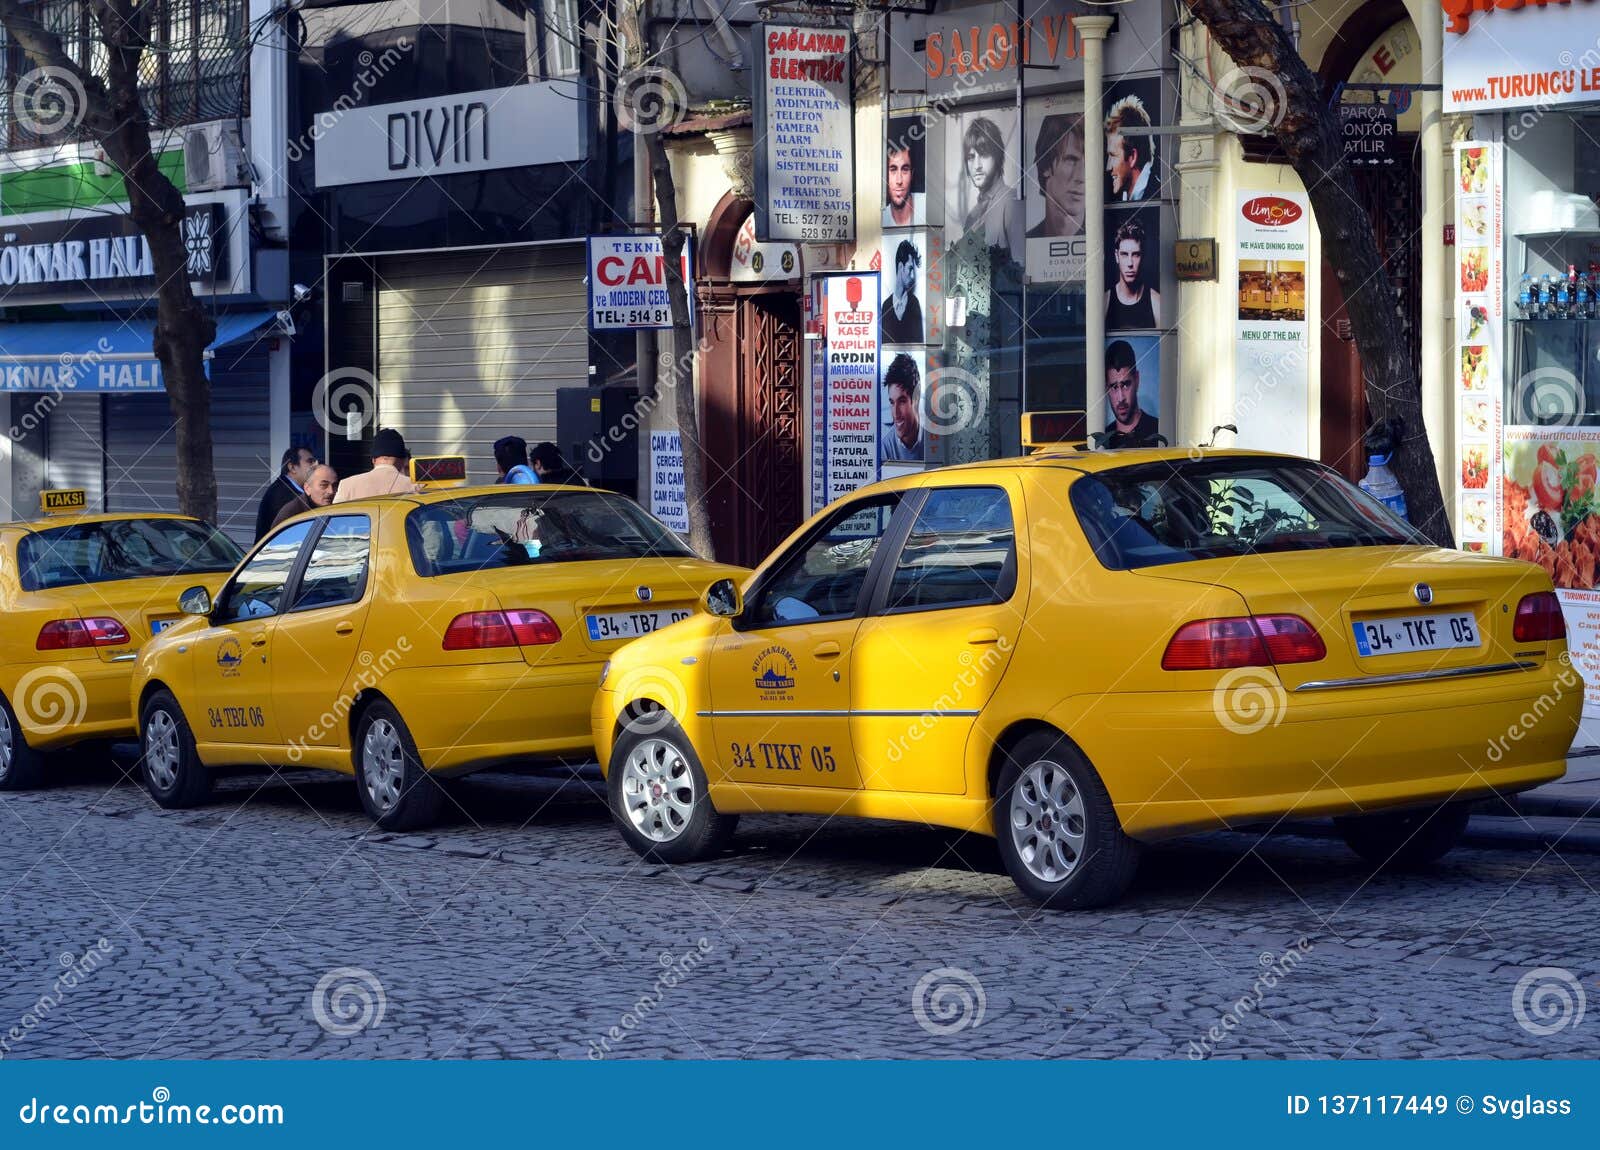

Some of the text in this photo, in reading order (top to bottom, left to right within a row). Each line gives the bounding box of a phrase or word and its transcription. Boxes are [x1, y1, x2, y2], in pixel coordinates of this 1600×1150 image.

[768, 28, 846, 55] ÇAĞLAYAN
[926, 13, 1085, 79] SALON VI
[770, 55, 846, 83] ELEKTRİK
[775, 85, 827, 98] ELEKTRİK
[775, 98, 840, 110] AYDINLATMA
[776, 110, 824, 121] TELEFON
[776, 123, 820, 134] KAMERA
[1342, 121, 1393, 136] ONTÖR
[776, 135, 812, 145] ALARM
[777, 146, 843, 159] ve GÜVENLİK
[1343, 140, 1385, 153] ATILIR
[776, 159, 840, 172] SİSTEMLERİ
[793, 175, 831, 185] TOPTAN
[782, 187, 842, 198] PERAKENDE
[773, 199, 821, 210] MALZEME
[774, 213, 849, 226] TEL: 527 27 19
[821, 229, 833, 239] 97
[836, 229, 848, 239] 44
[612, 239, 662, 253] TEKNİ
[1240, 241, 1249, 249] WE
[1265, 242, 1286, 250] DINING
[1287, 242, 1305, 251] ROOM
[596, 295, 607, 307] ve
[609, 291, 646, 307] MODERN
[596, 310, 668, 323] TEL: 514 81
[838, 312, 871, 323] ACELE
[838, 326, 870, 338] KAŞE
[1242, 330, 1301, 340] MENU OF THE DAY
[831, 340, 876, 350] YAPILIR
[831, 353, 875, 363] AYDIN
[832, 379, 872, 390] DÜĞÜN
[832, 393, 870, 405] NİŞAN
[832, 405, 870, 417] NİKAH
[832, 419, 871, 431] SÜNNET
[832, 447, 869, 456] FATURA
[832, 456, 874, 468] İRSALİYE
[833, 483, 858, 492] ZARF
[657, 504, 683, 516] JALUZİ
[599, 617, 620, 636] 34
[629, 613, 659, 634] TBZ
[1366, 623, 1393, 650] 34
[1402, 619, 1438, 647] TKF
[1449, 617, 1474, 643] 05
[208, 706, 265, 728] 34 TBZ 06
[731, 742, 837, 773] 34 TKF 05
